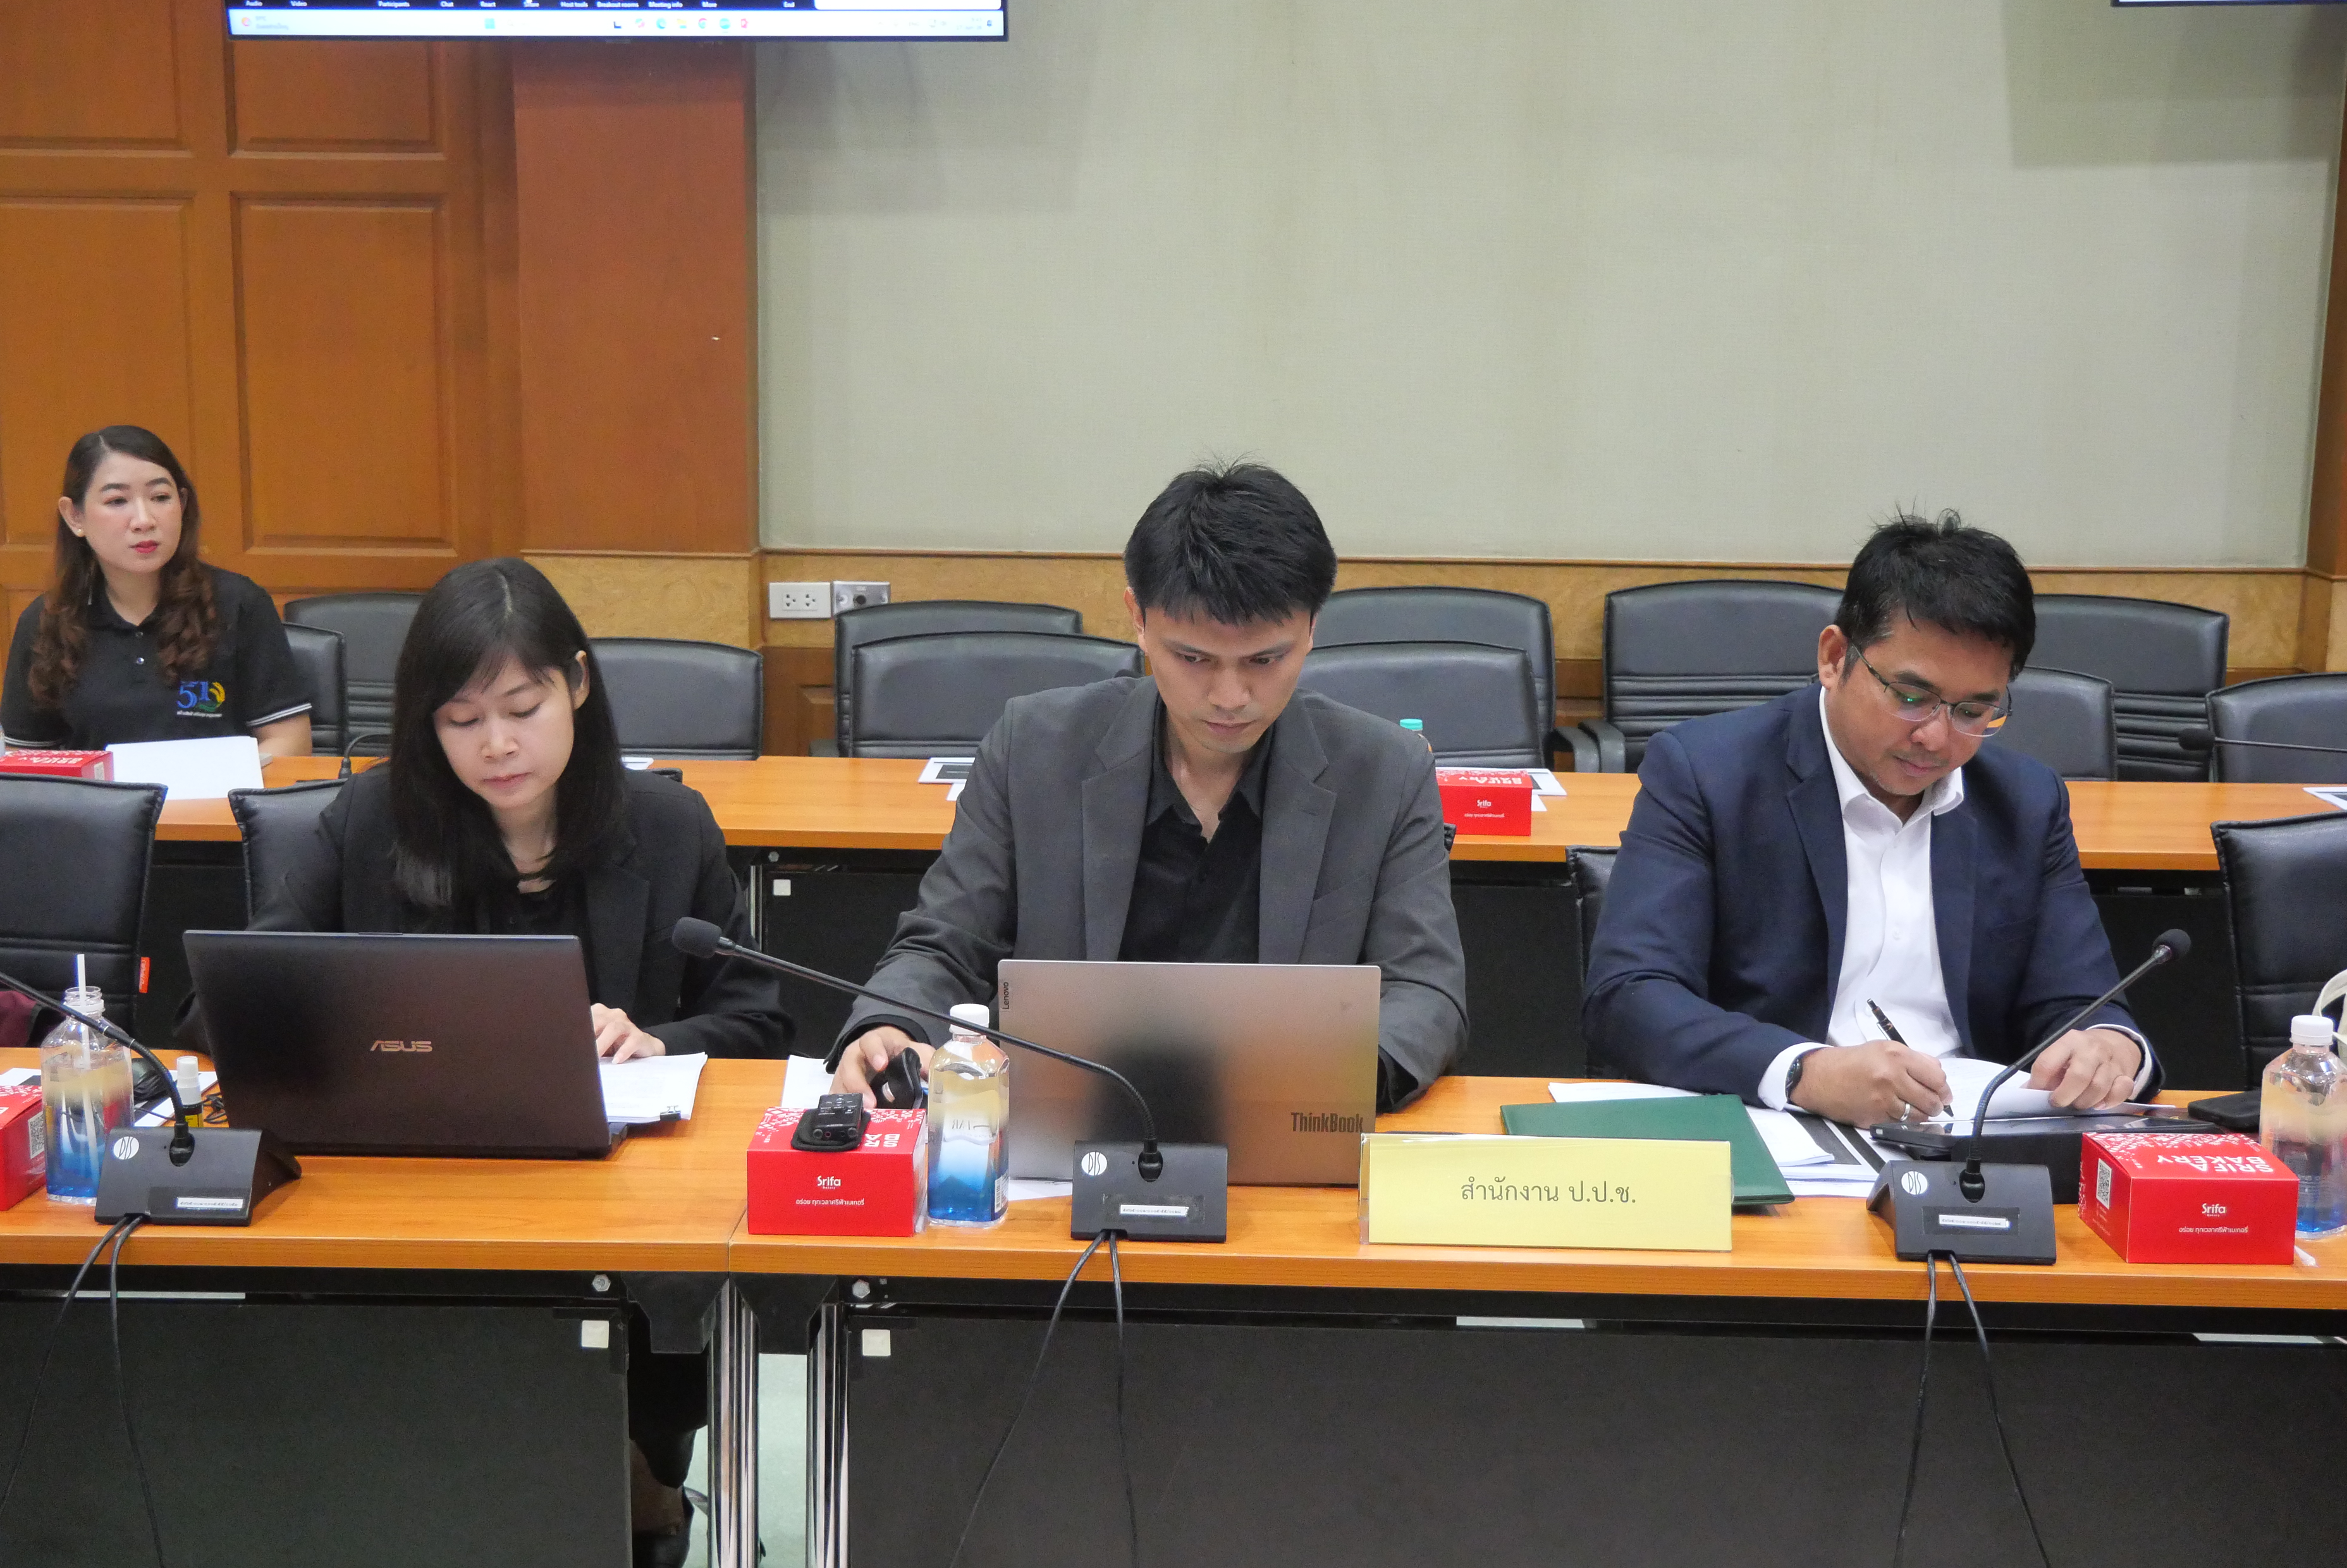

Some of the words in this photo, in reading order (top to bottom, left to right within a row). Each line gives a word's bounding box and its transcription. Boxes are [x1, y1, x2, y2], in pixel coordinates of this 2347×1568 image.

[370, 1040, 433, 1052] ASUS
[1290, 1112, 1364, 1133] ThinkBook
[2157, 1155, 2266, 1165] BAKERY
[2189, 1163, 2274, 1173] SRIFA
[817, 1175, 842, 1186] Srifa
[1461, 1175, 1559, 1202] สำนักงาน
[1568, 1180, 1636, 1204] ป.ป.ช.
[2202, 1203, 2226, 1214] Srifa
